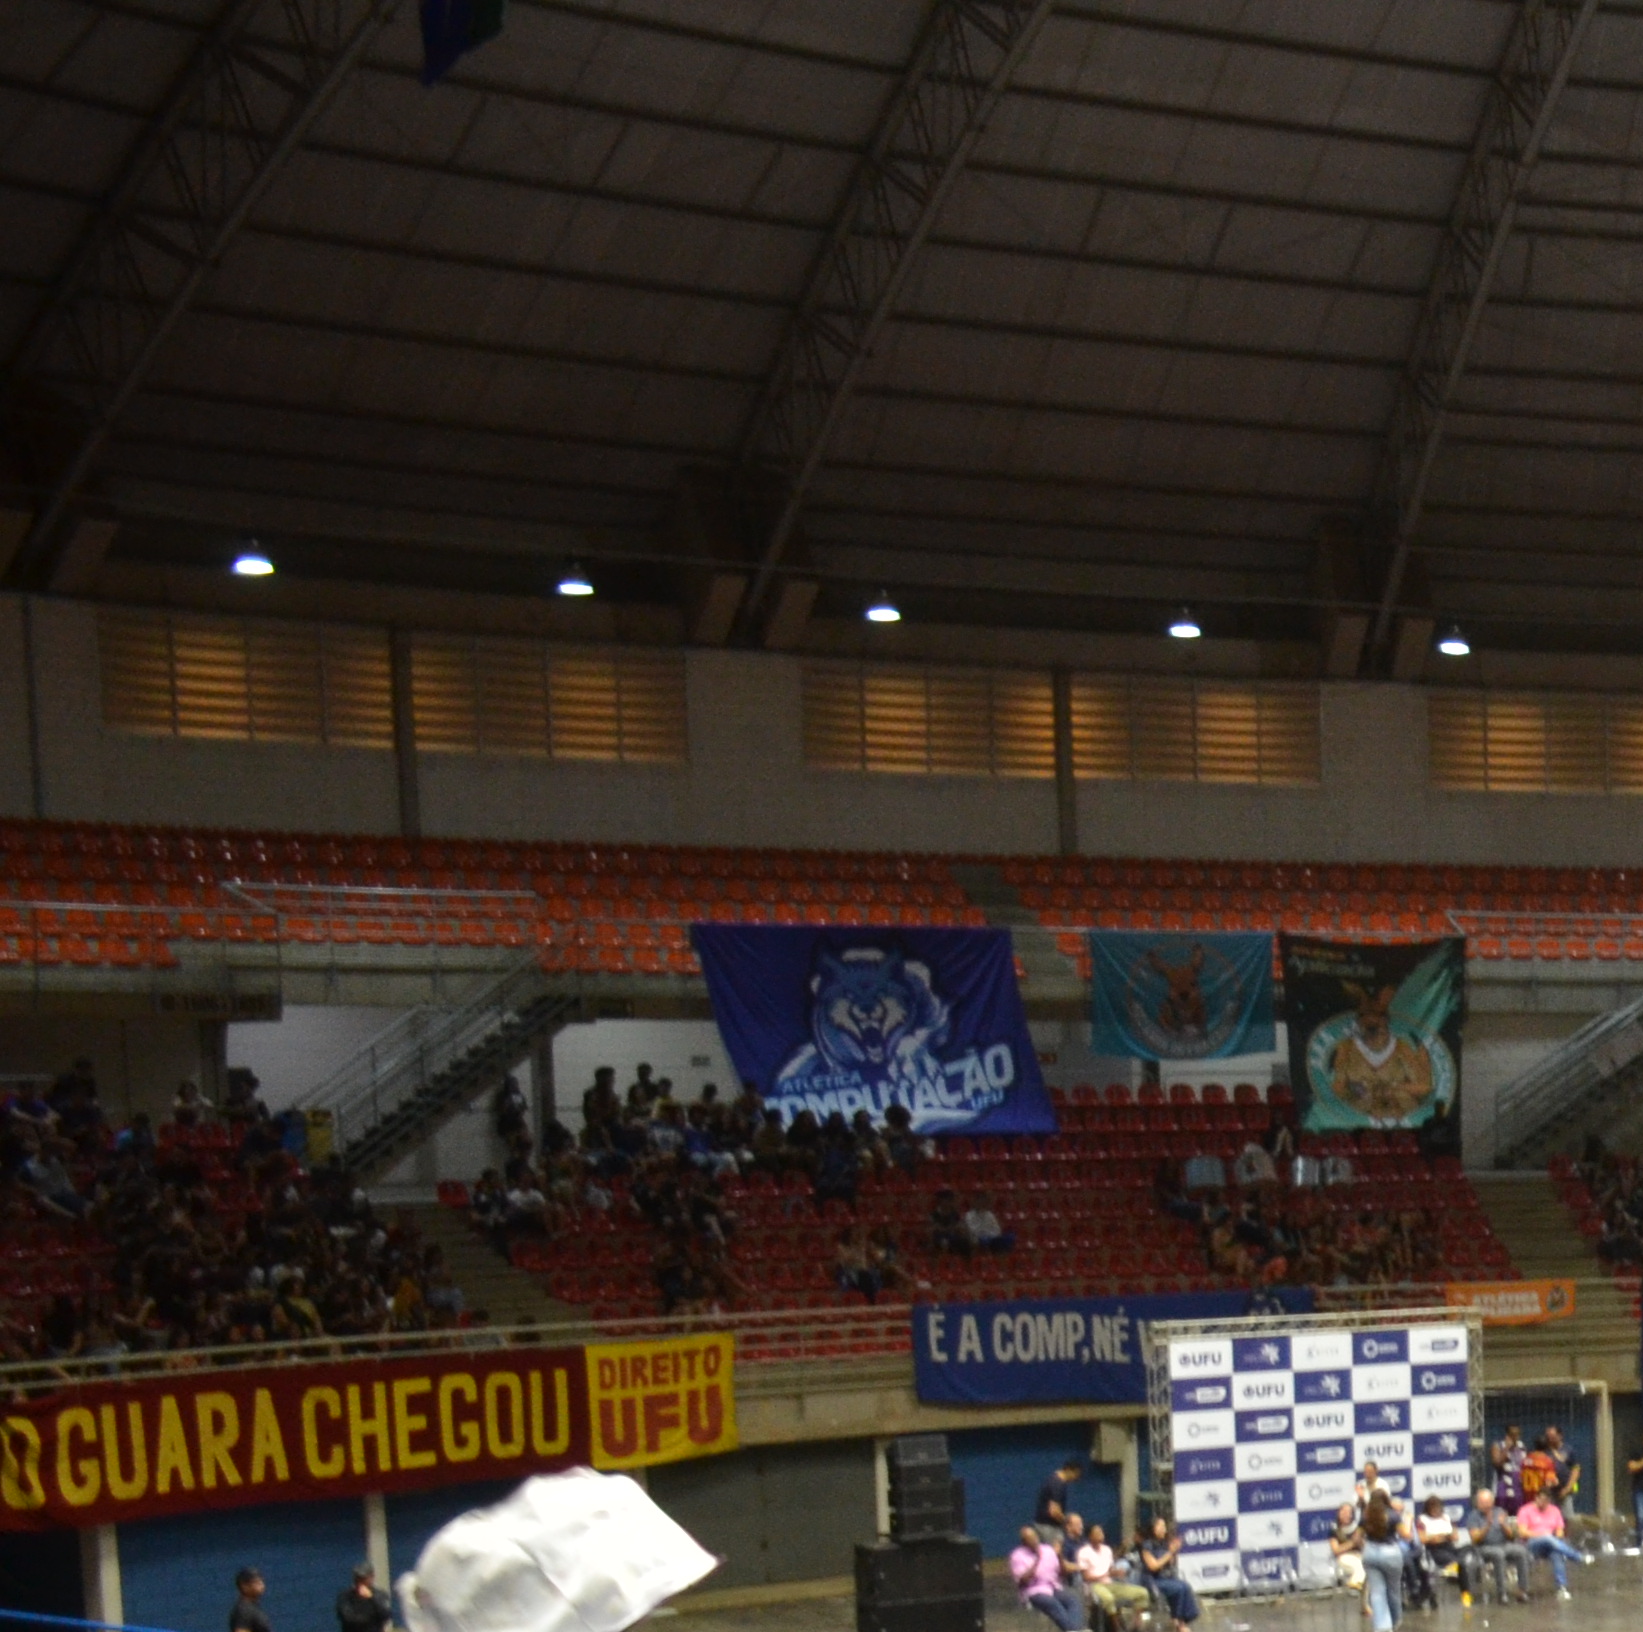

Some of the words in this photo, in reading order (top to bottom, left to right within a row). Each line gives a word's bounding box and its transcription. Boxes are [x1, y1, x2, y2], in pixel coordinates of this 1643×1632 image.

[957, 1313, 985, 1364] A
[598, 1344, 722, 1391] DIREITO
[1192, 1352, 1223, 1366] UFU
[1255, 1383, 1286, 1397] UFU
[598, 1383, 724, 1459] UFU
[1315, 1413, 1345, 1427] UFU
[56, 1386, 290, 1507] GUARA
[302, 1368, 571, 1479] CHEGOU
[1376, 1443, 1405, 1457] UFU
[1434, 1473, 1463, 1486] UFU
[1197, 1525, 1230, 1545] UFU
